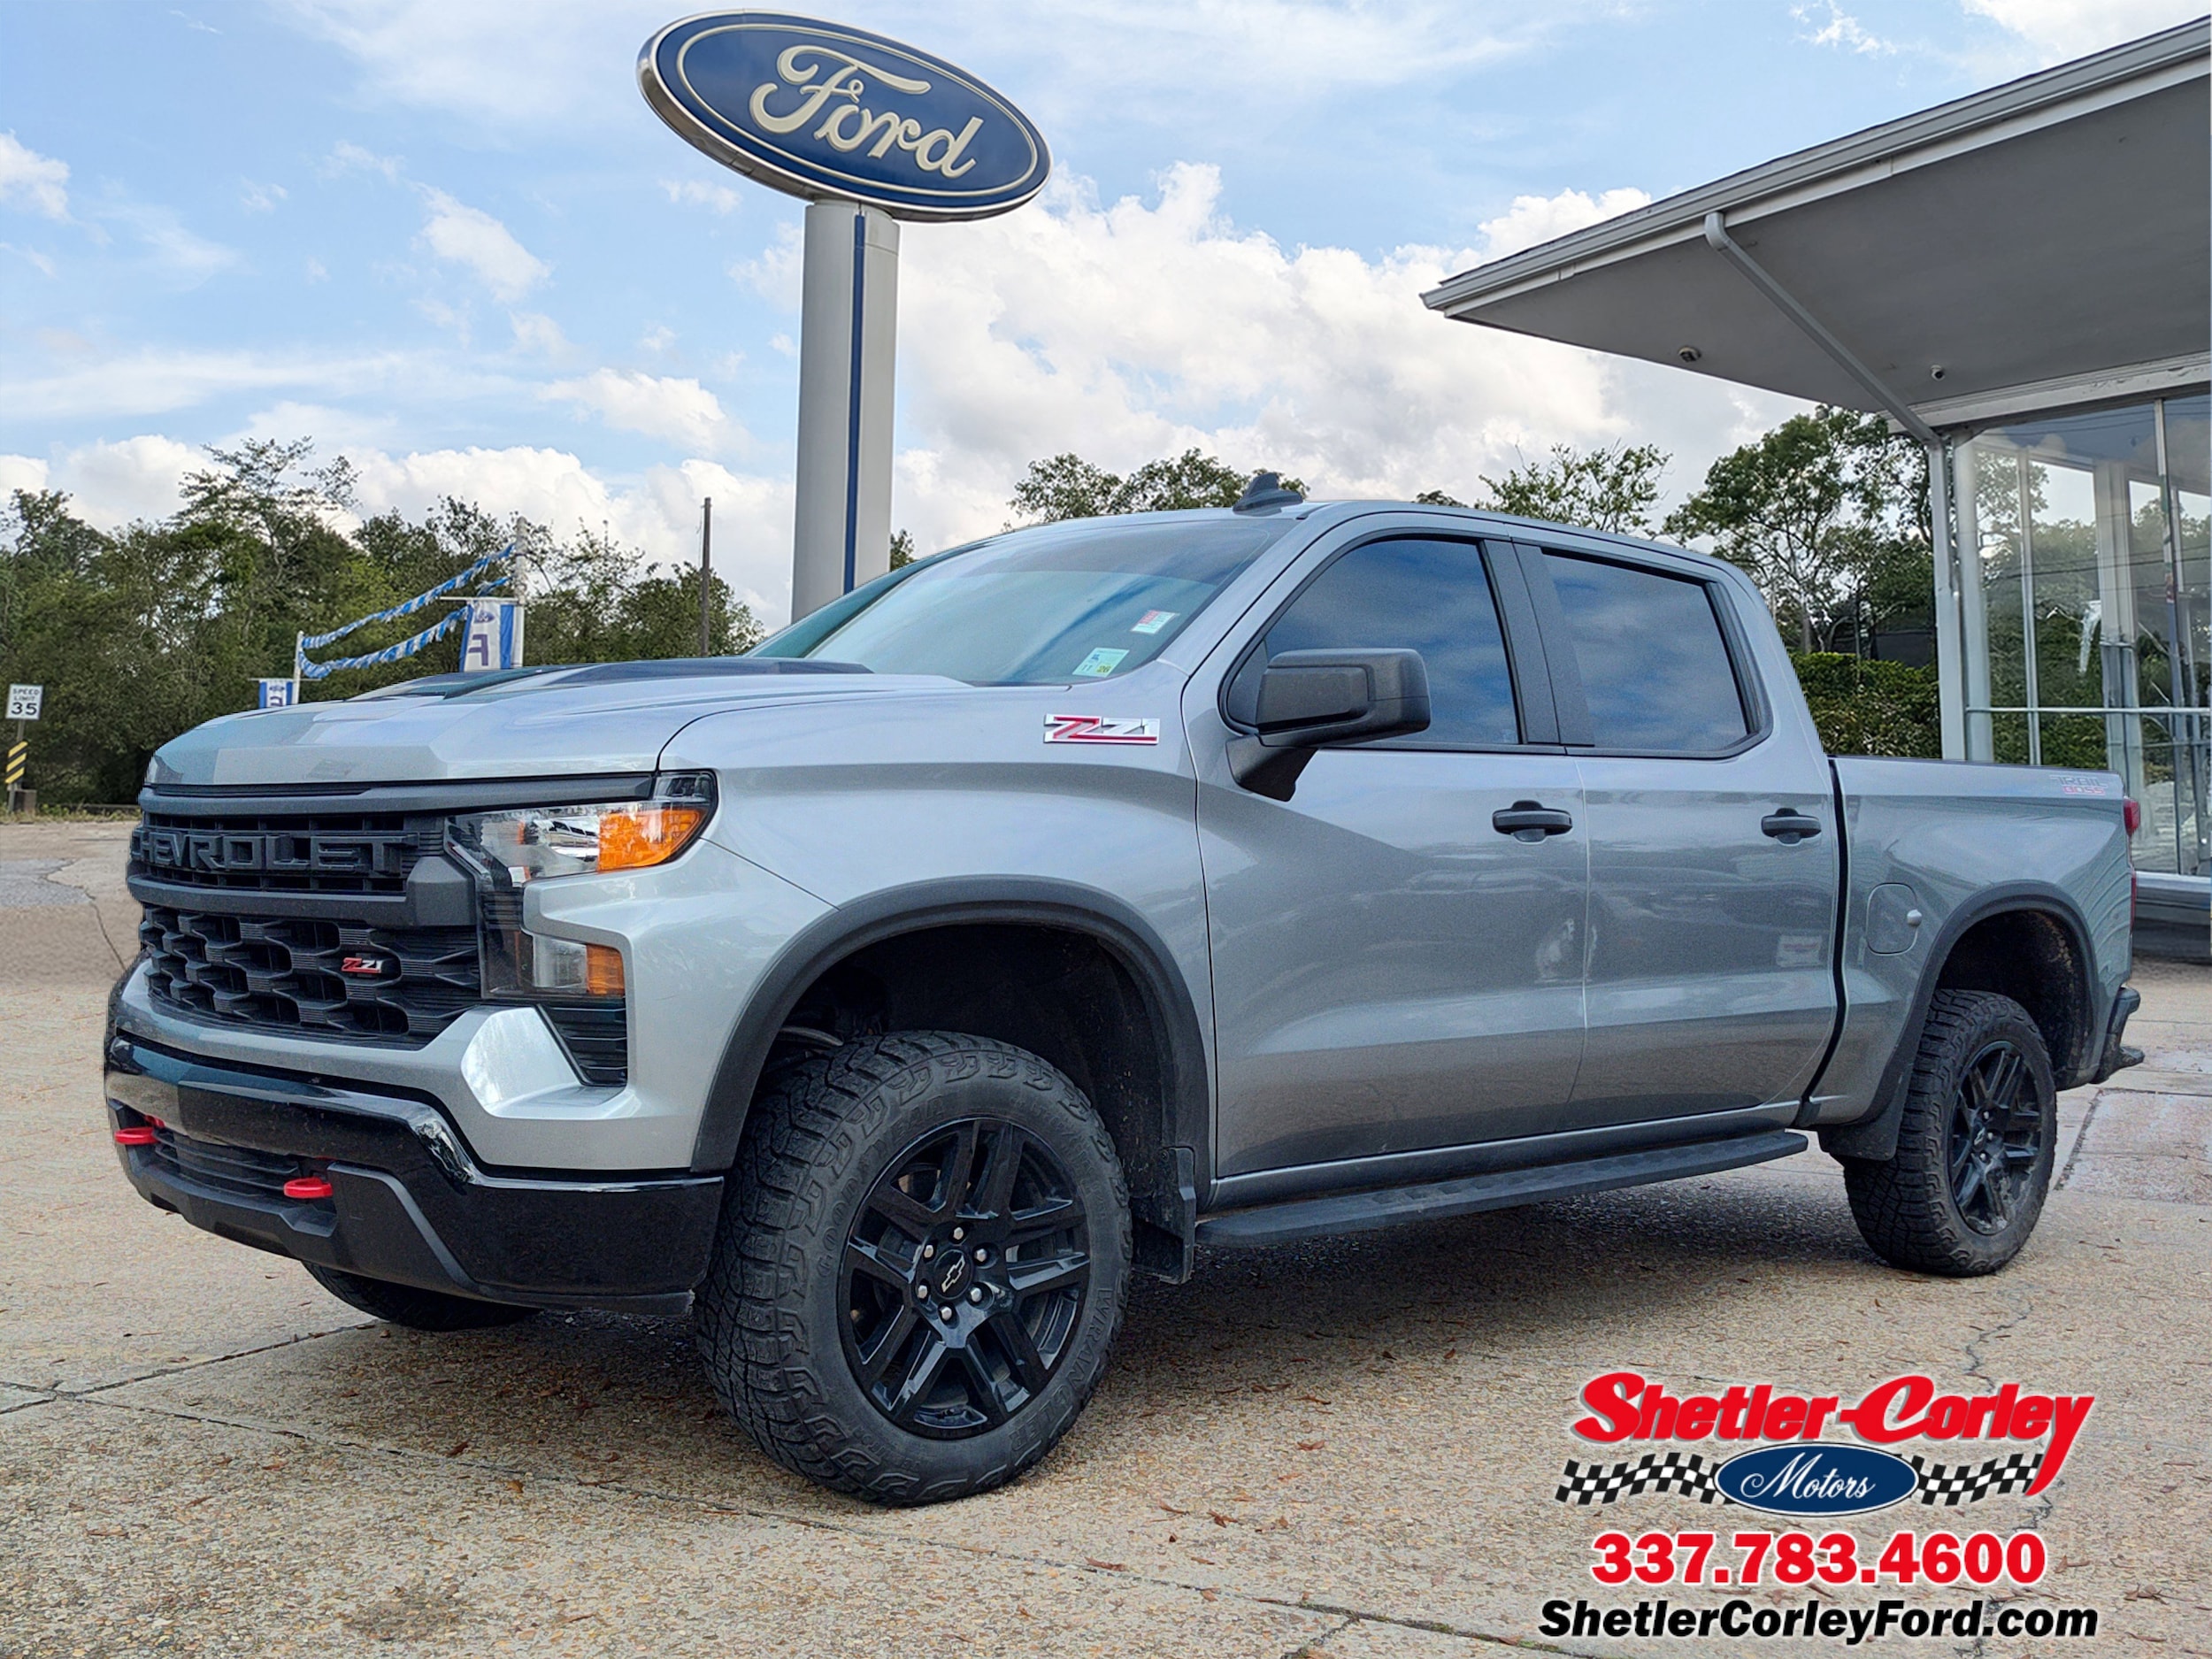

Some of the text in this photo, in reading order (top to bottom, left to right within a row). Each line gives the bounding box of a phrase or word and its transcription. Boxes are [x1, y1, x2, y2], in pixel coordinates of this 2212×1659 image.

[749, 44, 984, 179] Ford
[11, 702, 37, 716] 35
[1044, 713, 1160, 745] Z71
[2049, 774, 2109, 787] TRAIL
[2062, 786, 2105, 795] BOSS
[342, 956, 382, 973] Z71
